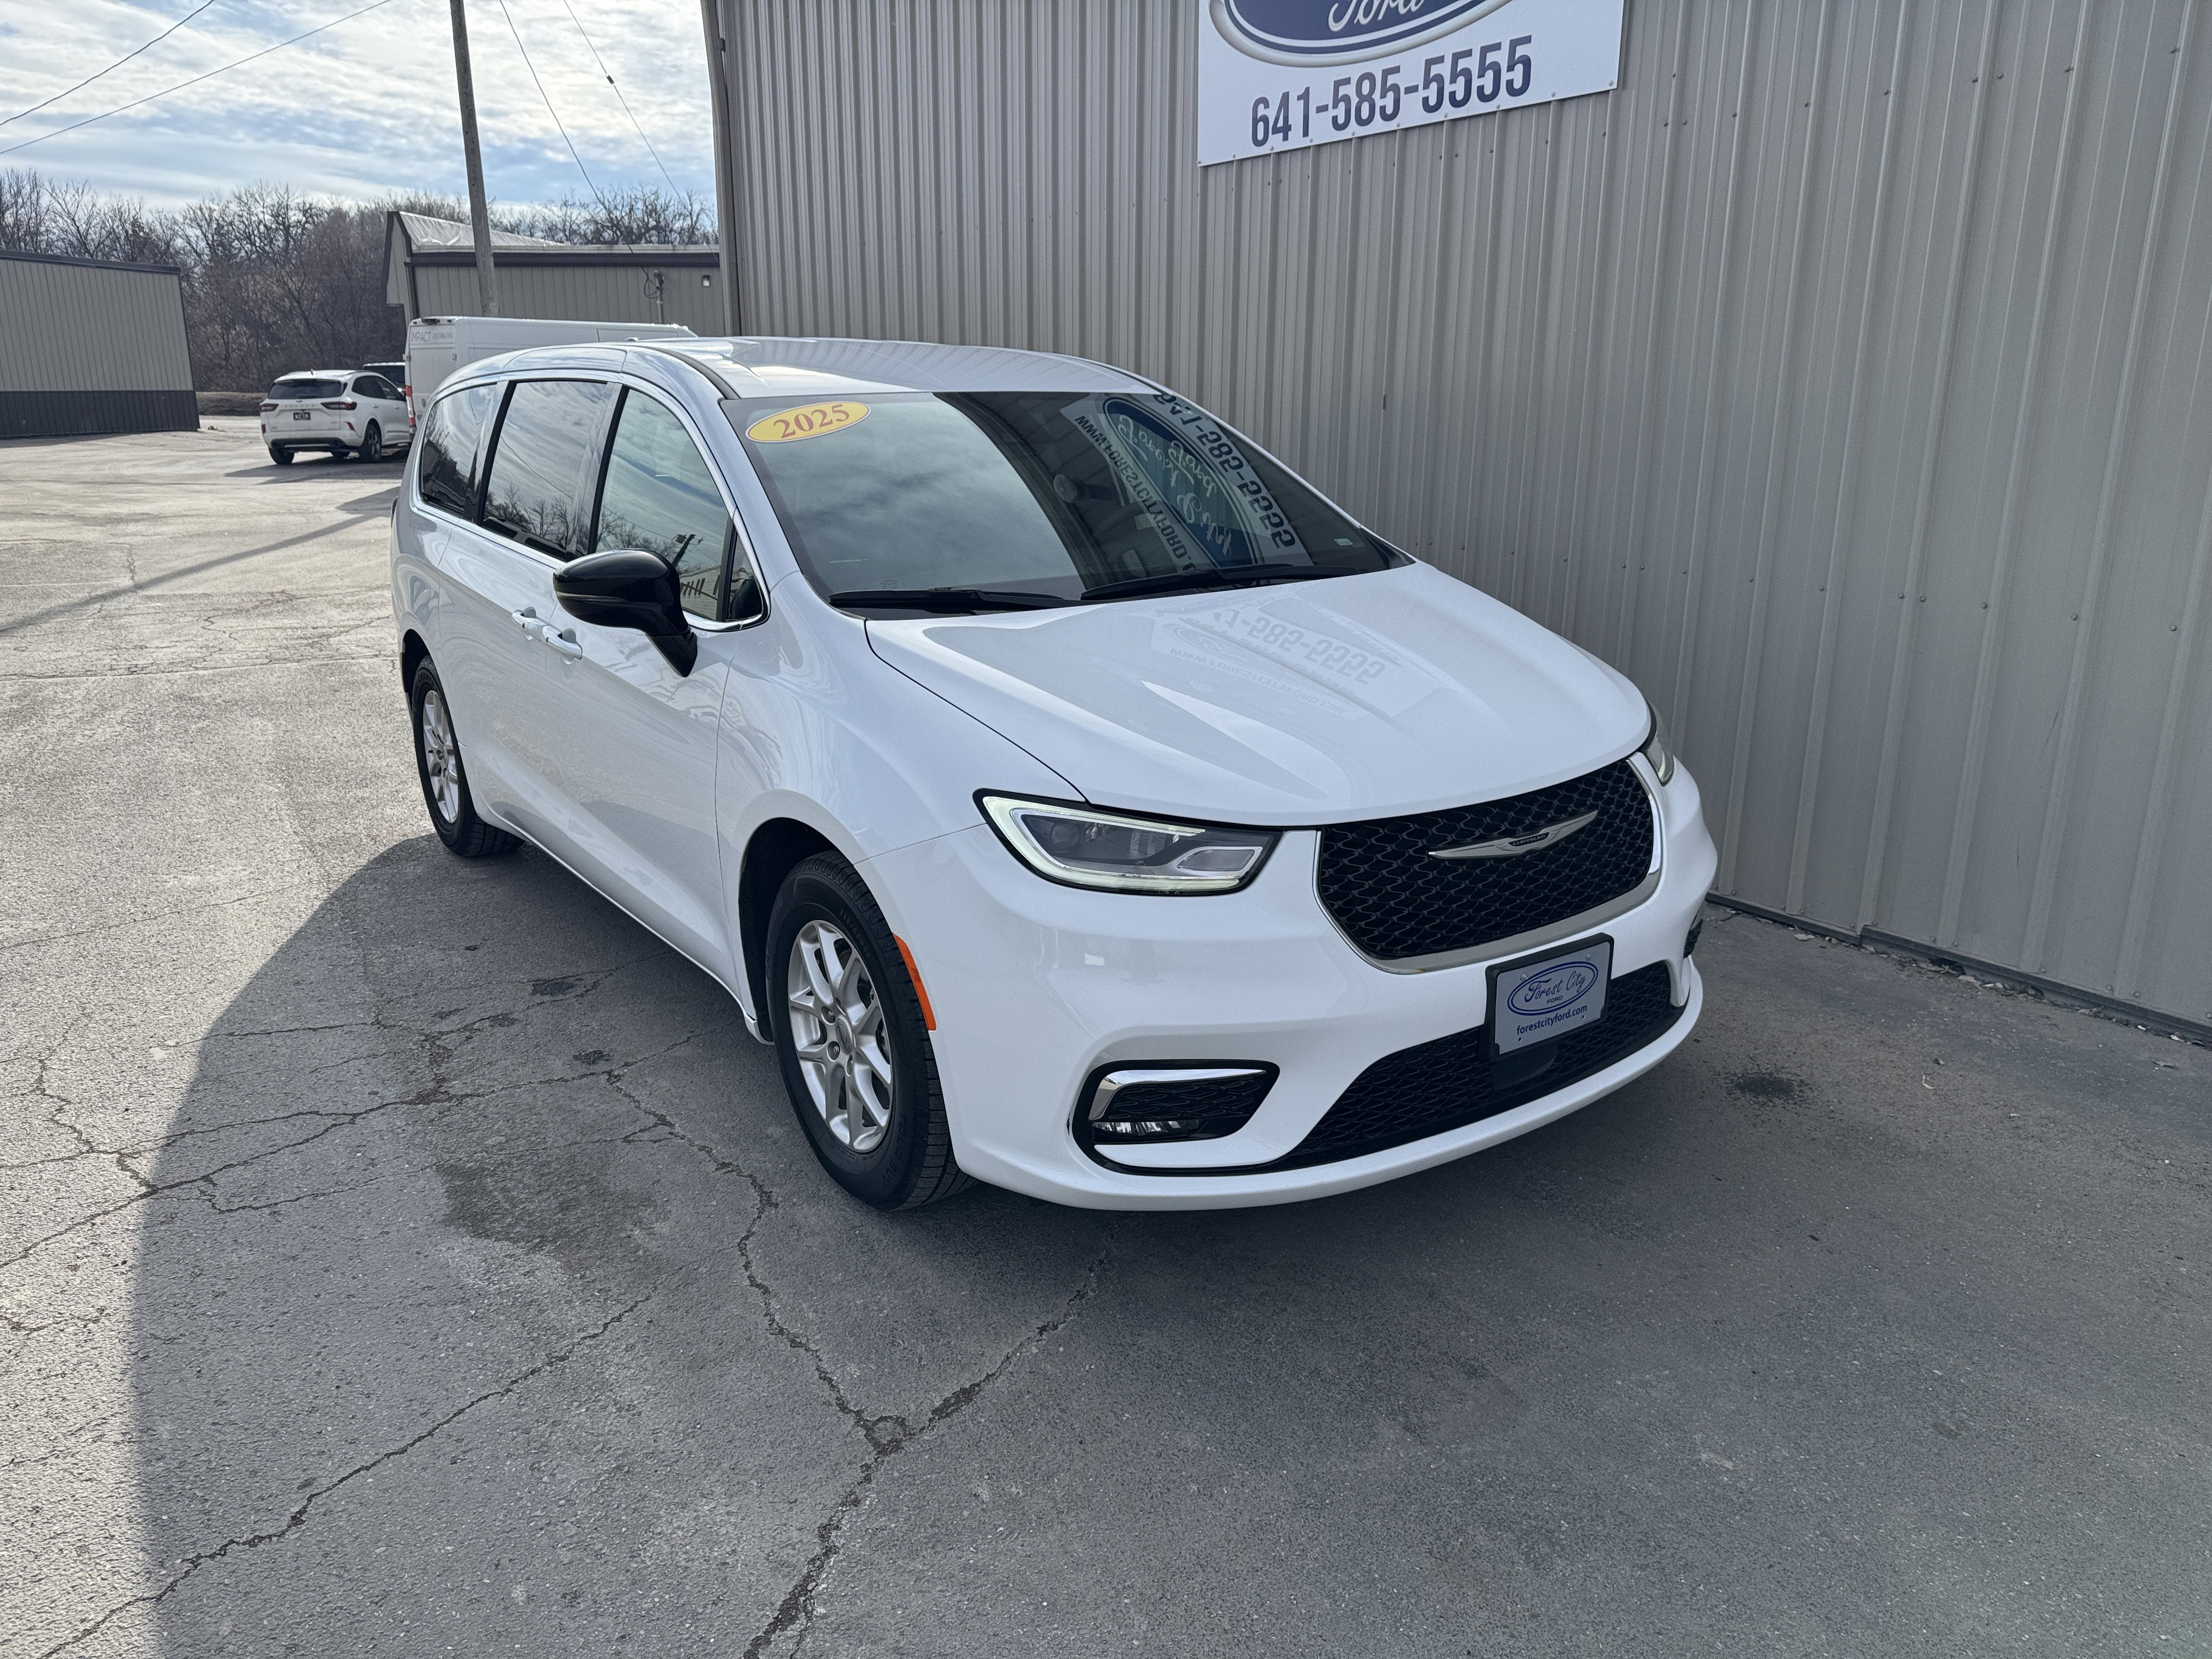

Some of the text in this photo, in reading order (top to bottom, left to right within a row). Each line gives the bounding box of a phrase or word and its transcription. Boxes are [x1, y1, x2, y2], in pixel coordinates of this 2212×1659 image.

[1251, 35, 1532, 148] 641-585-5555
[773, 404, 850, 438] 2025
[1524, 970, 1585, 1002] Forest City
[1547, 995, 1563, 1005] FORD
[1516, 1005, 1587, 1035] forestcityford.com
